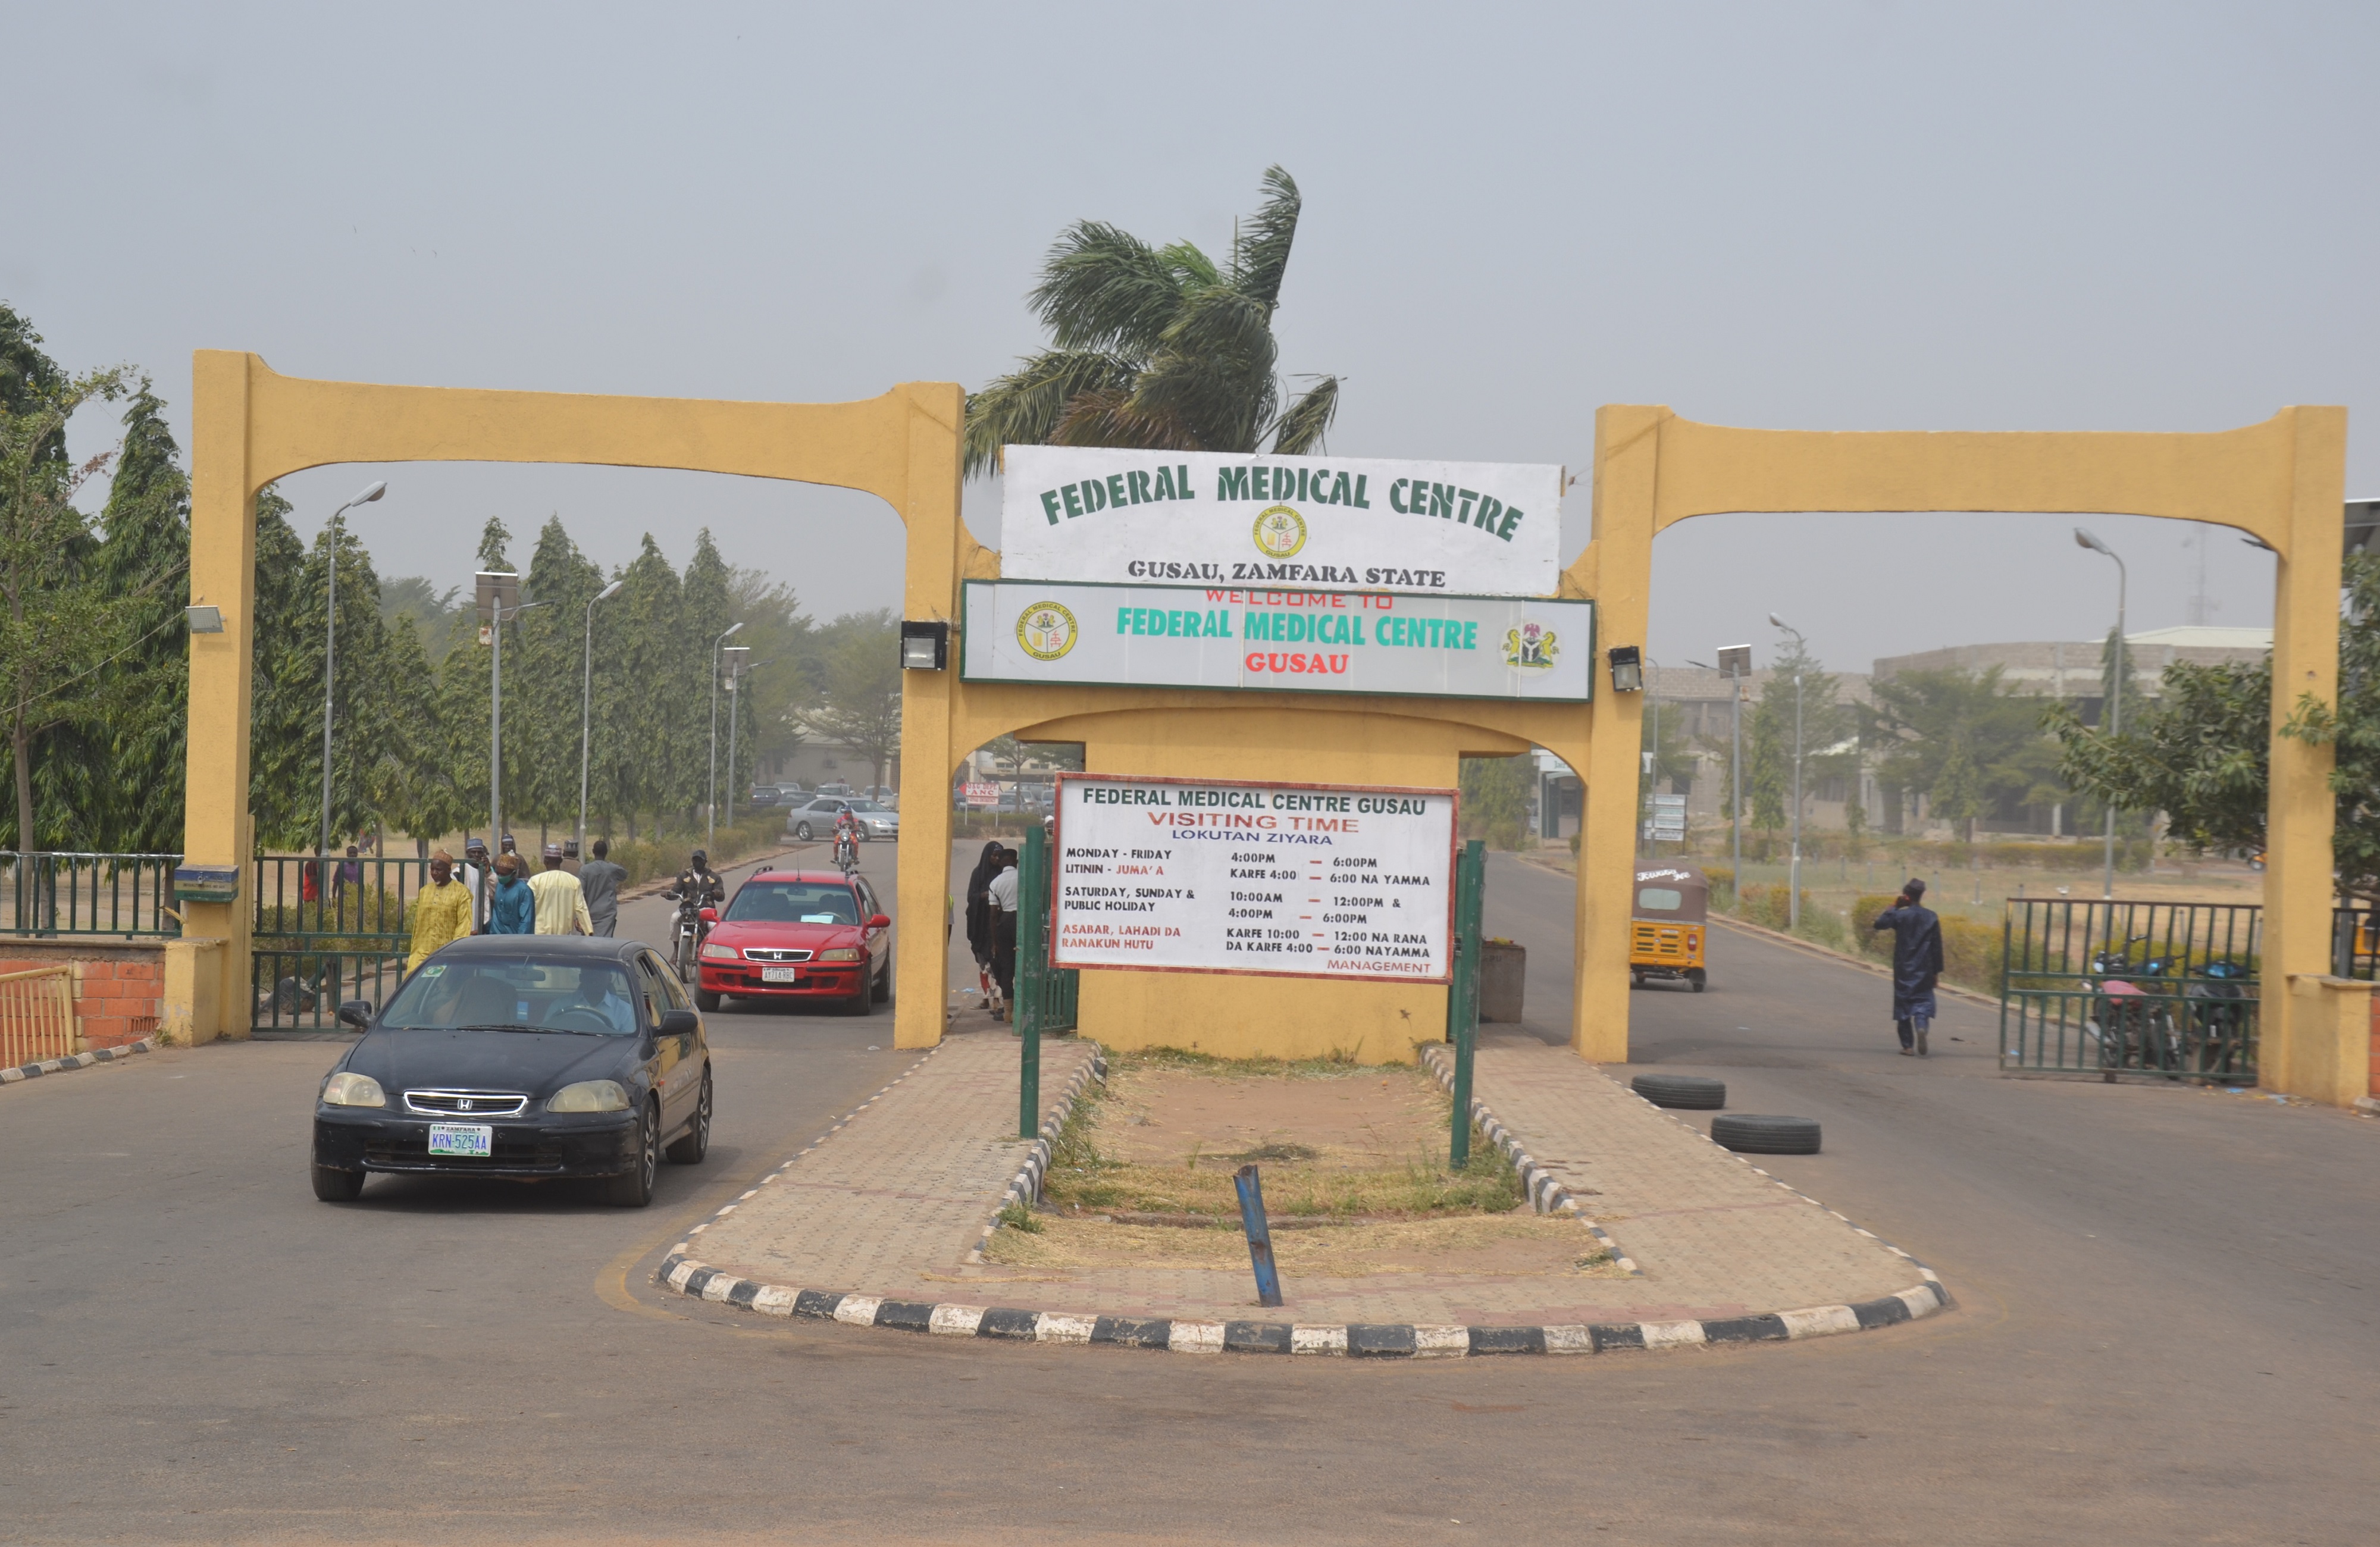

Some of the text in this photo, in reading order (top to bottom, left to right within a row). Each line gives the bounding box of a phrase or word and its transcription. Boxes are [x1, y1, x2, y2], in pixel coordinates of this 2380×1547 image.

[1040, 465, 1523, 542] FEDERAL MEDICAL CENTRE
[1254, 507, 1305, 537] FEDERAL MEDICAL CENTRE
[1128, 560, 1445, 587] GUSAU, ZAMFARA STATE
[1205, 590, 1393, 610] WELCOME TO
[1018, 610, 1032, 637] FEDERAL
[1062, 610, 1076, 633] CENTRE
[1117, 607, 1477, 649] FEDERAL MEDICAL CENTRE
[1246, 653, 1348, 674] GUSAU
[1084, 788, 1426, 815] FEDERAL MEDICAL CENTRE GUSAU
[1147, 812, 1358, 832] VISITING TIME
[1173, 830, 1332, 844] LOKUTAN ZIYARA
[1067, 848, 1118, 857] MONDAY
[1132, 850, 1171, 859] FRIDAY
[1232, 853, 1274, 863] 4:00PM
[1333, 857, 1376, 867] 6:00PM
[1066, 865, 1103, 873] LITININ
[1231, 869, 1265, 878] KARFE
[1270, 870, 1296, 879] 4:00
[1330, 873, 1356, 883] 6:00
[1362, 875, 1378, 884] NA
[1385, 875, 1429, 885] YAMMA
[1066, 887, 1195, 899] SATURDAY, SUNDAY &
[1231, 891, 1282, 902] 10:00AM
[1335, 897, 1383, 907] 12:00PM
[1392, 898, 1401, 909] &
[1065, 901, 1155, 912] PUBLIC HOLIDAY
[1229, 909, 1272, 919] 4:00PM
[1323, 913, 1366, 923] 6:00PM
[1063, 925, 1180, 937] ASABAR, LAHADI DA
[1227, 929, 1261, 938] KARFE
[1268, 929, 1299, 939] 10:00
[1335, 931, 1367, 941] 12:00
[1372, 933, 1388, 942] NA
[1394, 934, 1426, 944] RANA
[1062, 938, 1153, 949] RANAKUN HUTU
[1227, 941, 1242, 950] DA
[1248, 942, 1282, 951] KARFE
[1287, 944, 1312, 953] 4:00
[1335, 945, 1361, 954] 6:00
[1327, 960, 1431, 973] MANAGEMENT
